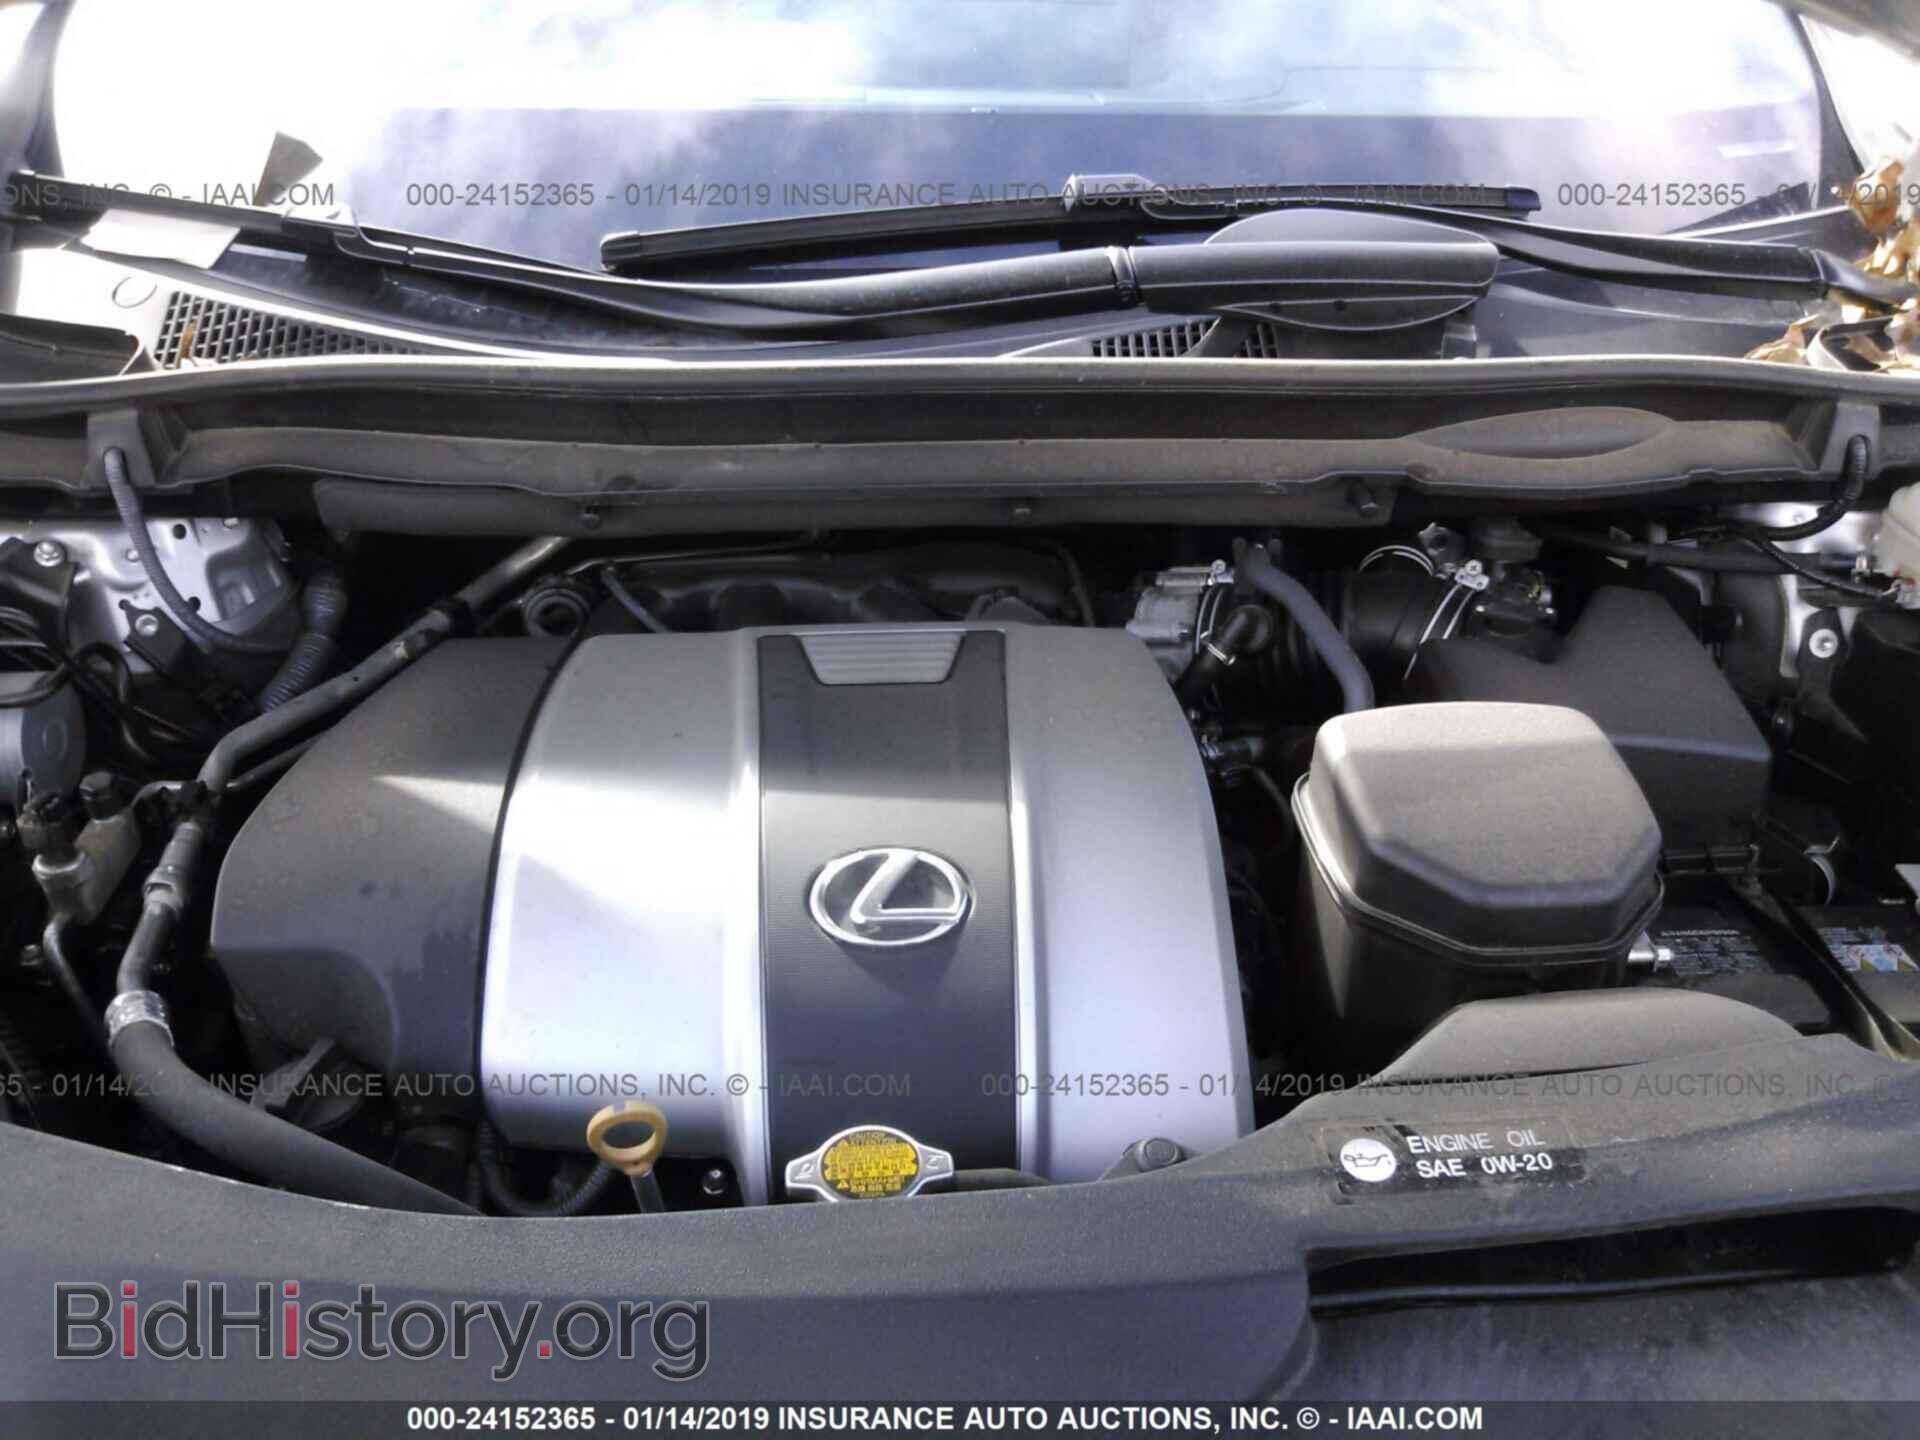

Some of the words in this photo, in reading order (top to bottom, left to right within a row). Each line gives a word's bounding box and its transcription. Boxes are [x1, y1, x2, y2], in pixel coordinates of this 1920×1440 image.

[1406, 1131, 1493, 1154] ENGINE
[1506, 1129, 1546, 1148] OIL
[1416, 1158, 1467, 1179] SAE
[1480, 1152, 1553, 1175] 0W-20
